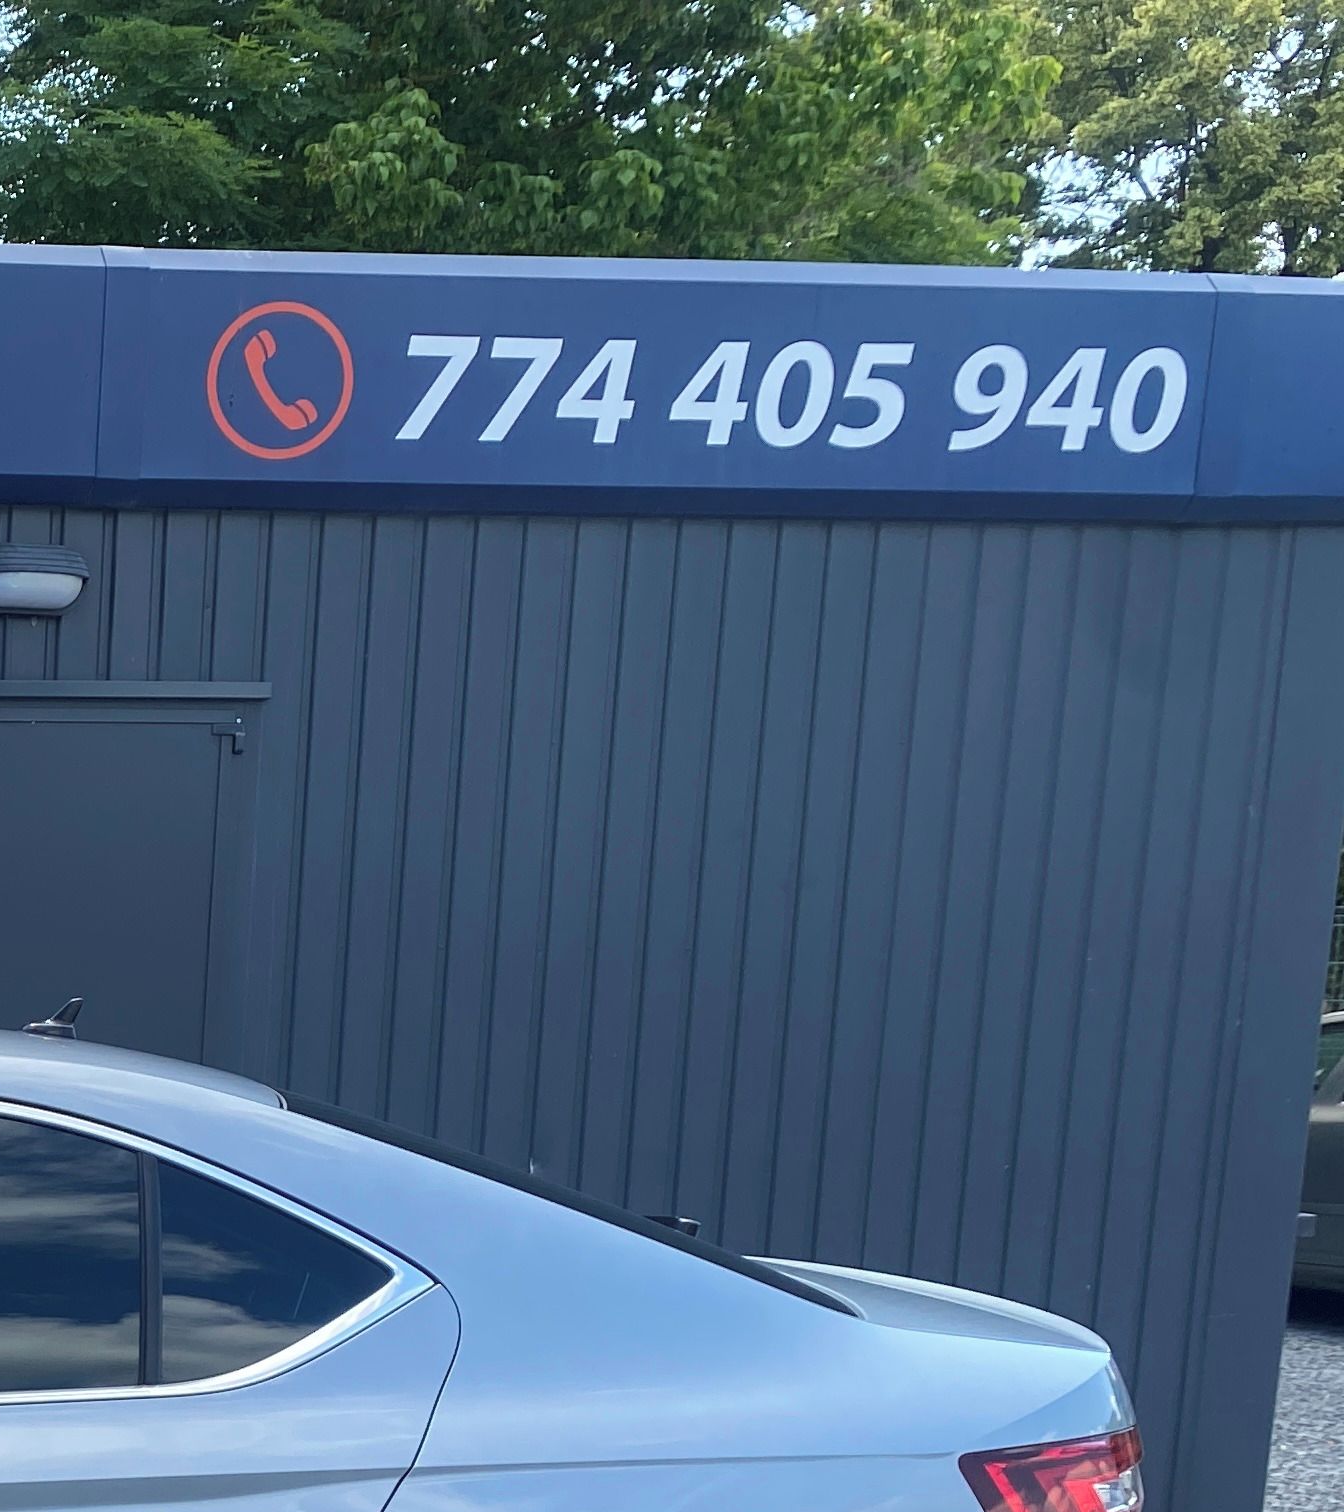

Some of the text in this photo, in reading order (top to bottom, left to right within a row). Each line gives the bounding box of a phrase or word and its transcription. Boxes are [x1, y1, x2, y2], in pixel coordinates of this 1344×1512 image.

[395, 334, 1188, 453] 774 405 940
